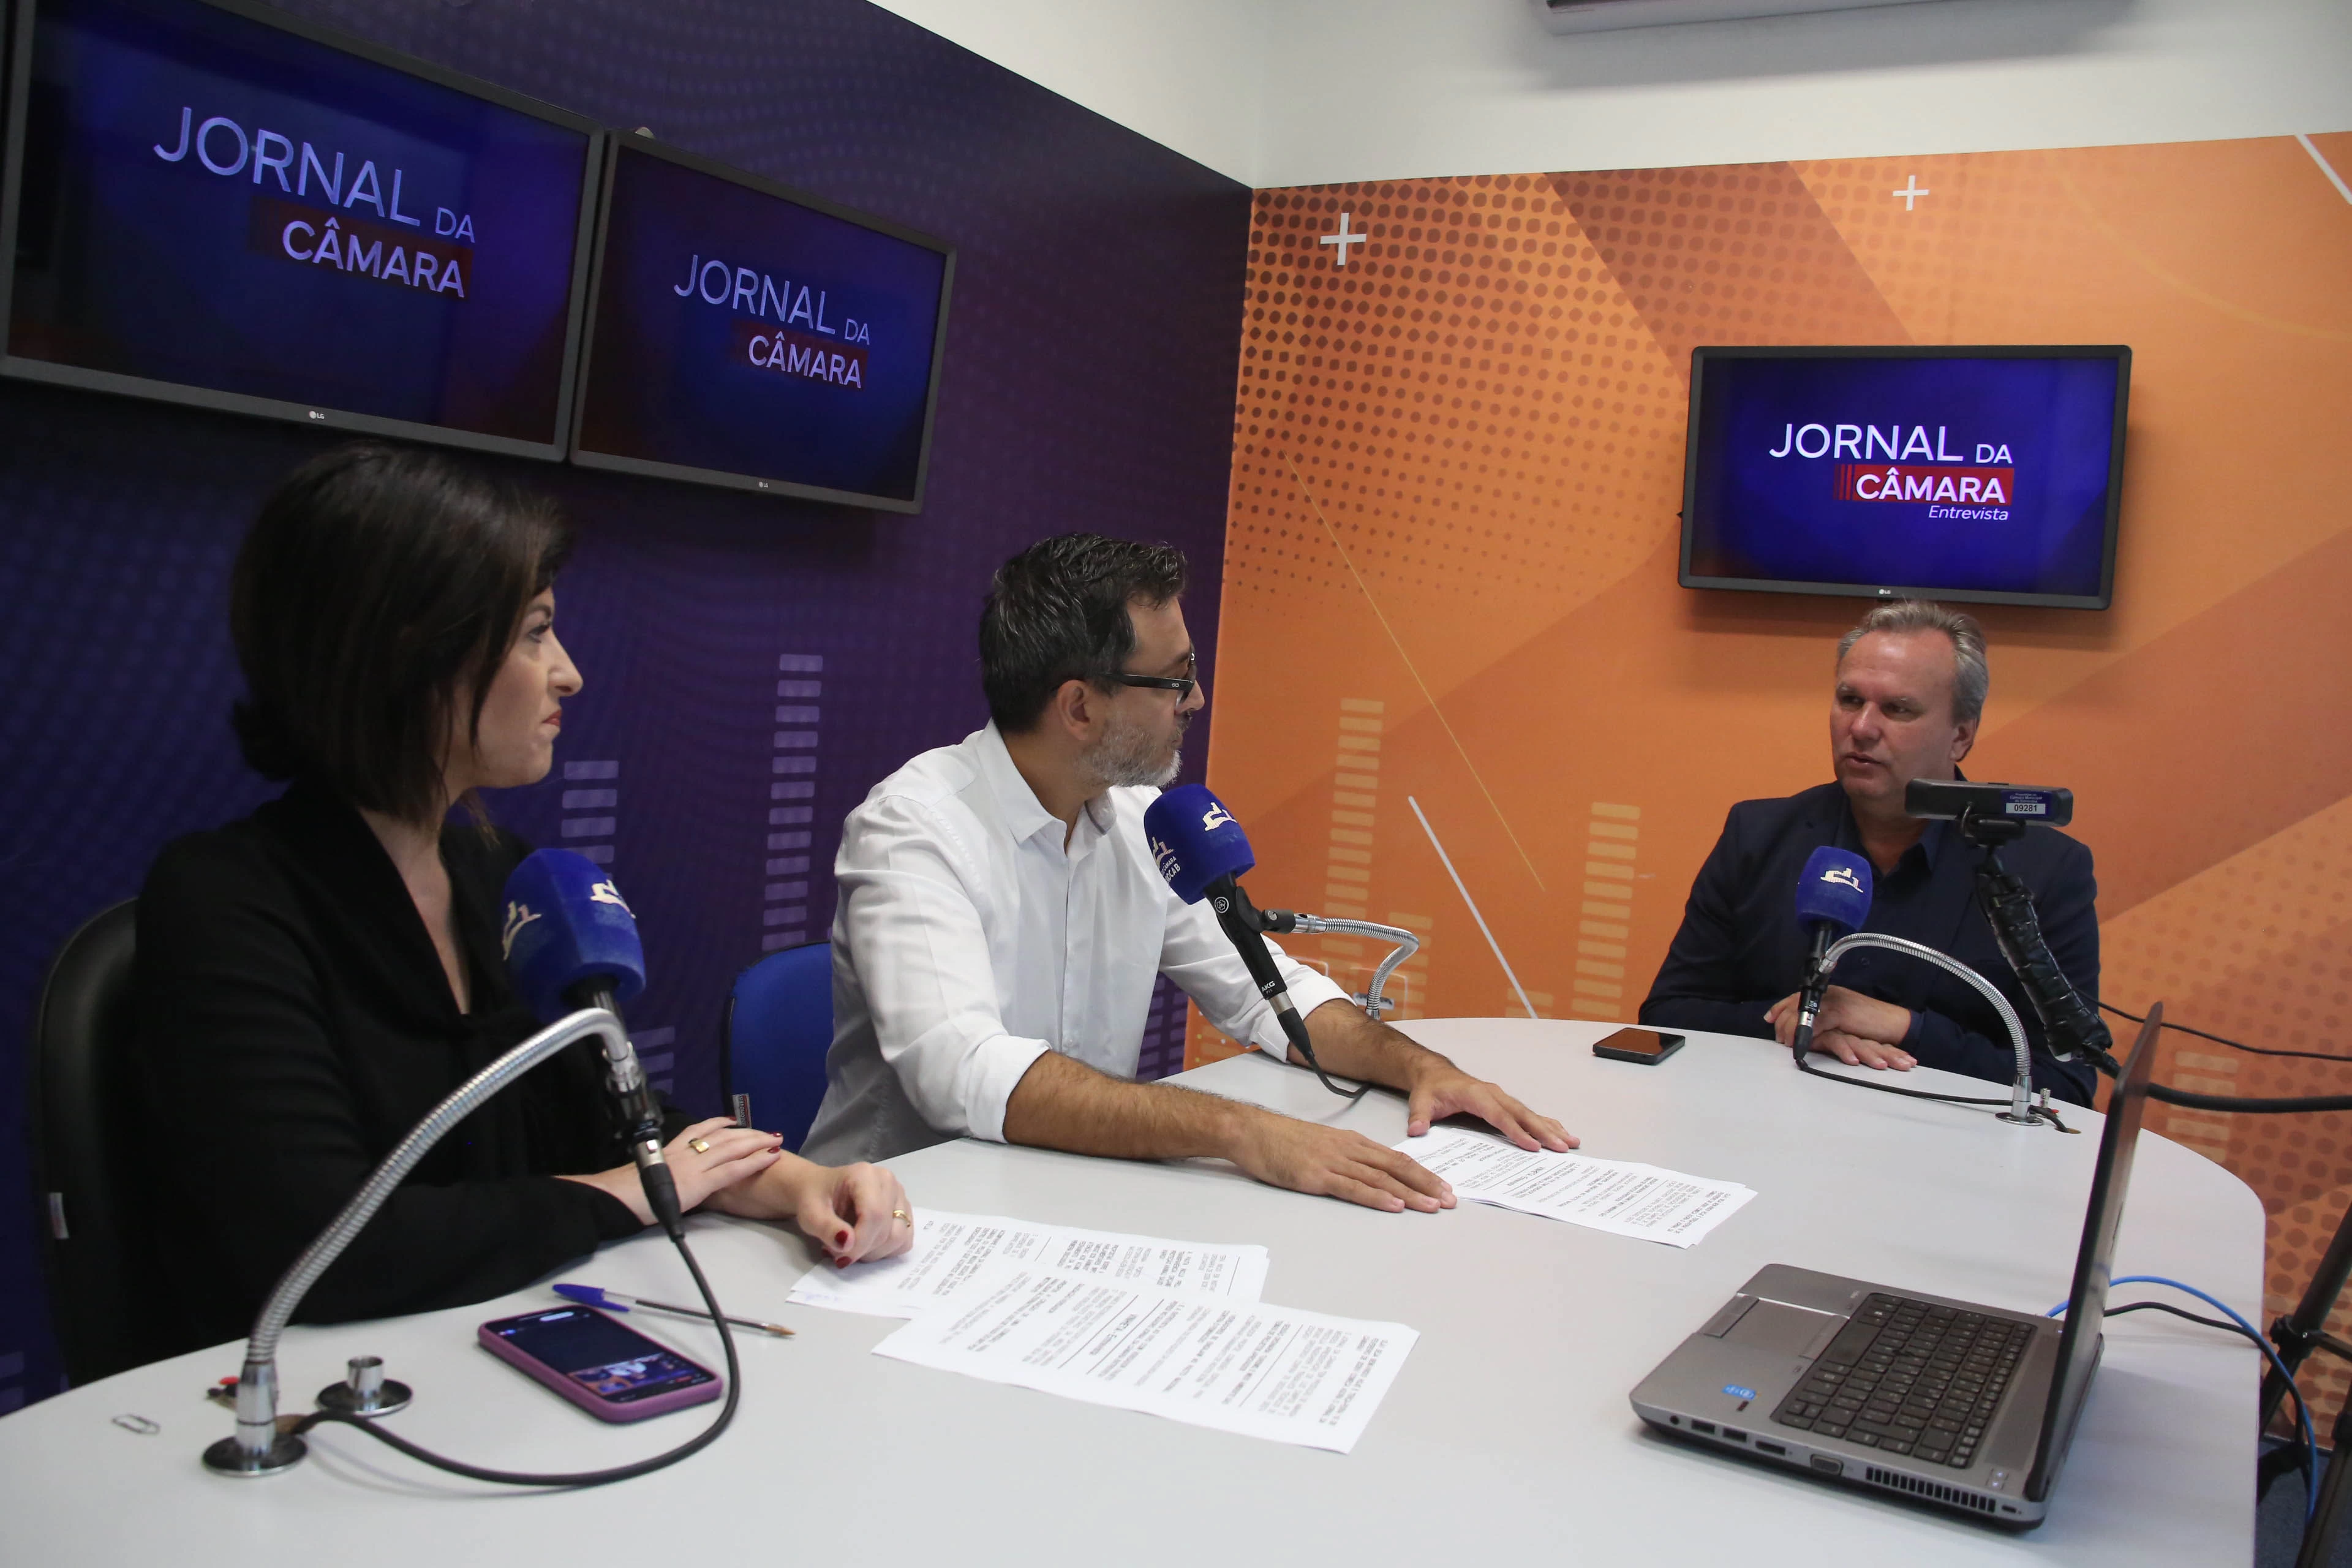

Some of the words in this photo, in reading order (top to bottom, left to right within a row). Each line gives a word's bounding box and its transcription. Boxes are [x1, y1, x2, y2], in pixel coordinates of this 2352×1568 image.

[153, 107, 420, 227] JORNAL
[435, 207, 475, 243] DA
[282, 217, 466, 298] CÂMARA
[673, 254, 836, 335] JORNAL
[844, 318, 870, 345] DA
[748, 331, 862, 389] CÂMARA
[1769, 423, 1964, 462] JORNAL
[1976, 443, 2013, 464] DA
[1855, 467, 2007, 504] CÂMARA
[1928, 505, 2010, 521] Entrevista
